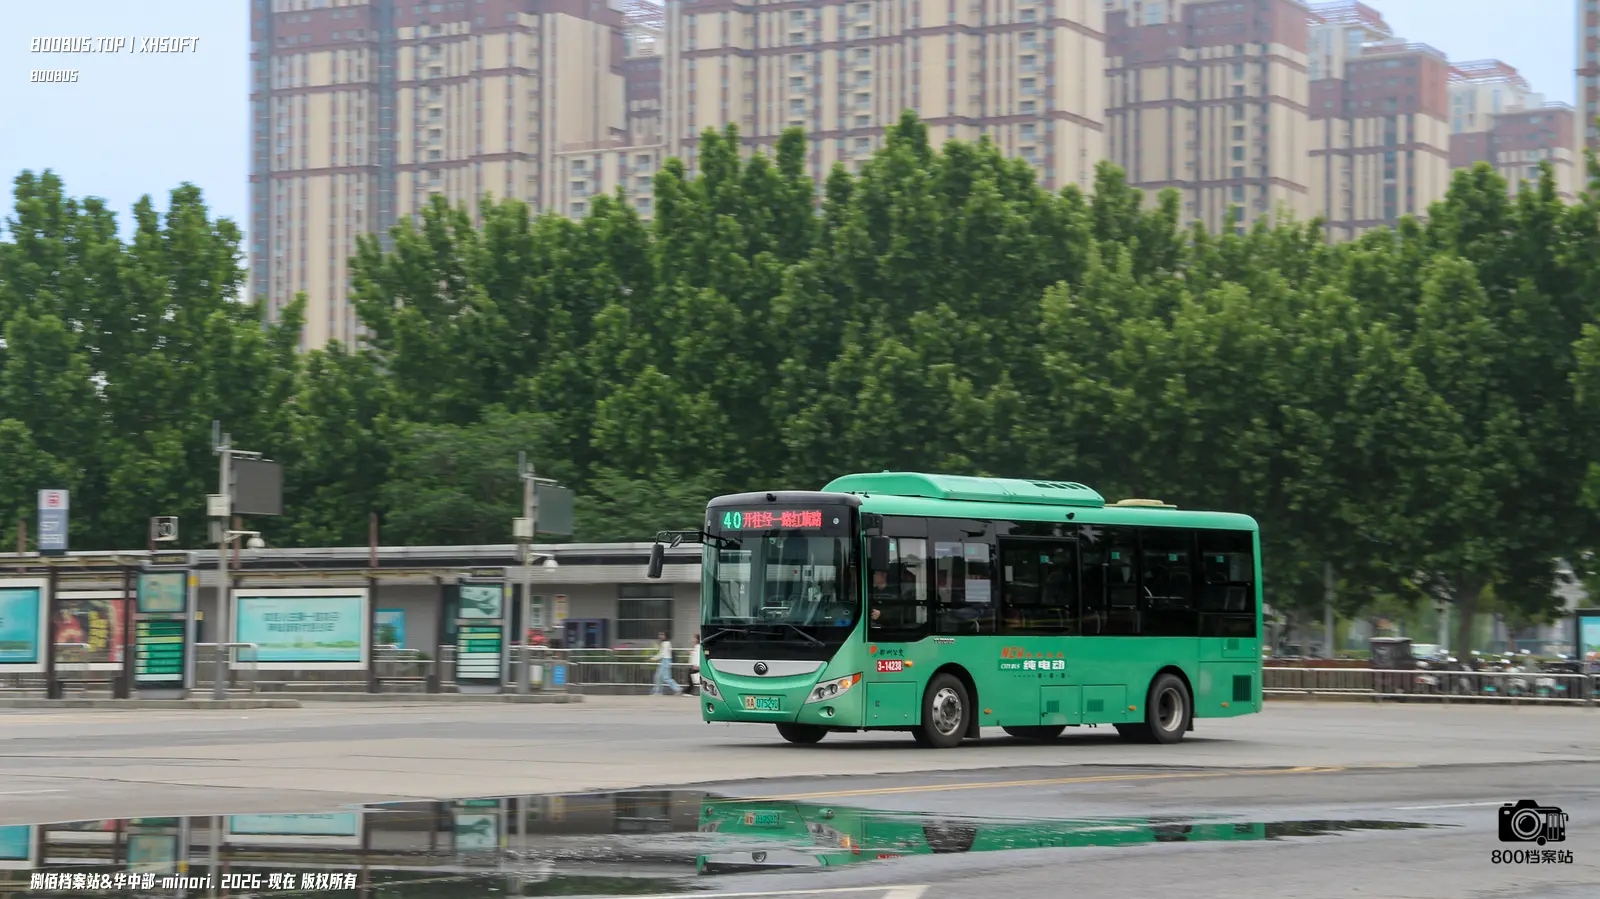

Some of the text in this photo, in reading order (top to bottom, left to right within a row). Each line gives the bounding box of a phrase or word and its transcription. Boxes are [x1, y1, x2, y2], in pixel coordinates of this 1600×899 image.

[723, 511, 742, 529] 40
[877, 660, 902, 671] 3-14238
[1023, 660, 1065, 670] 纯电动
